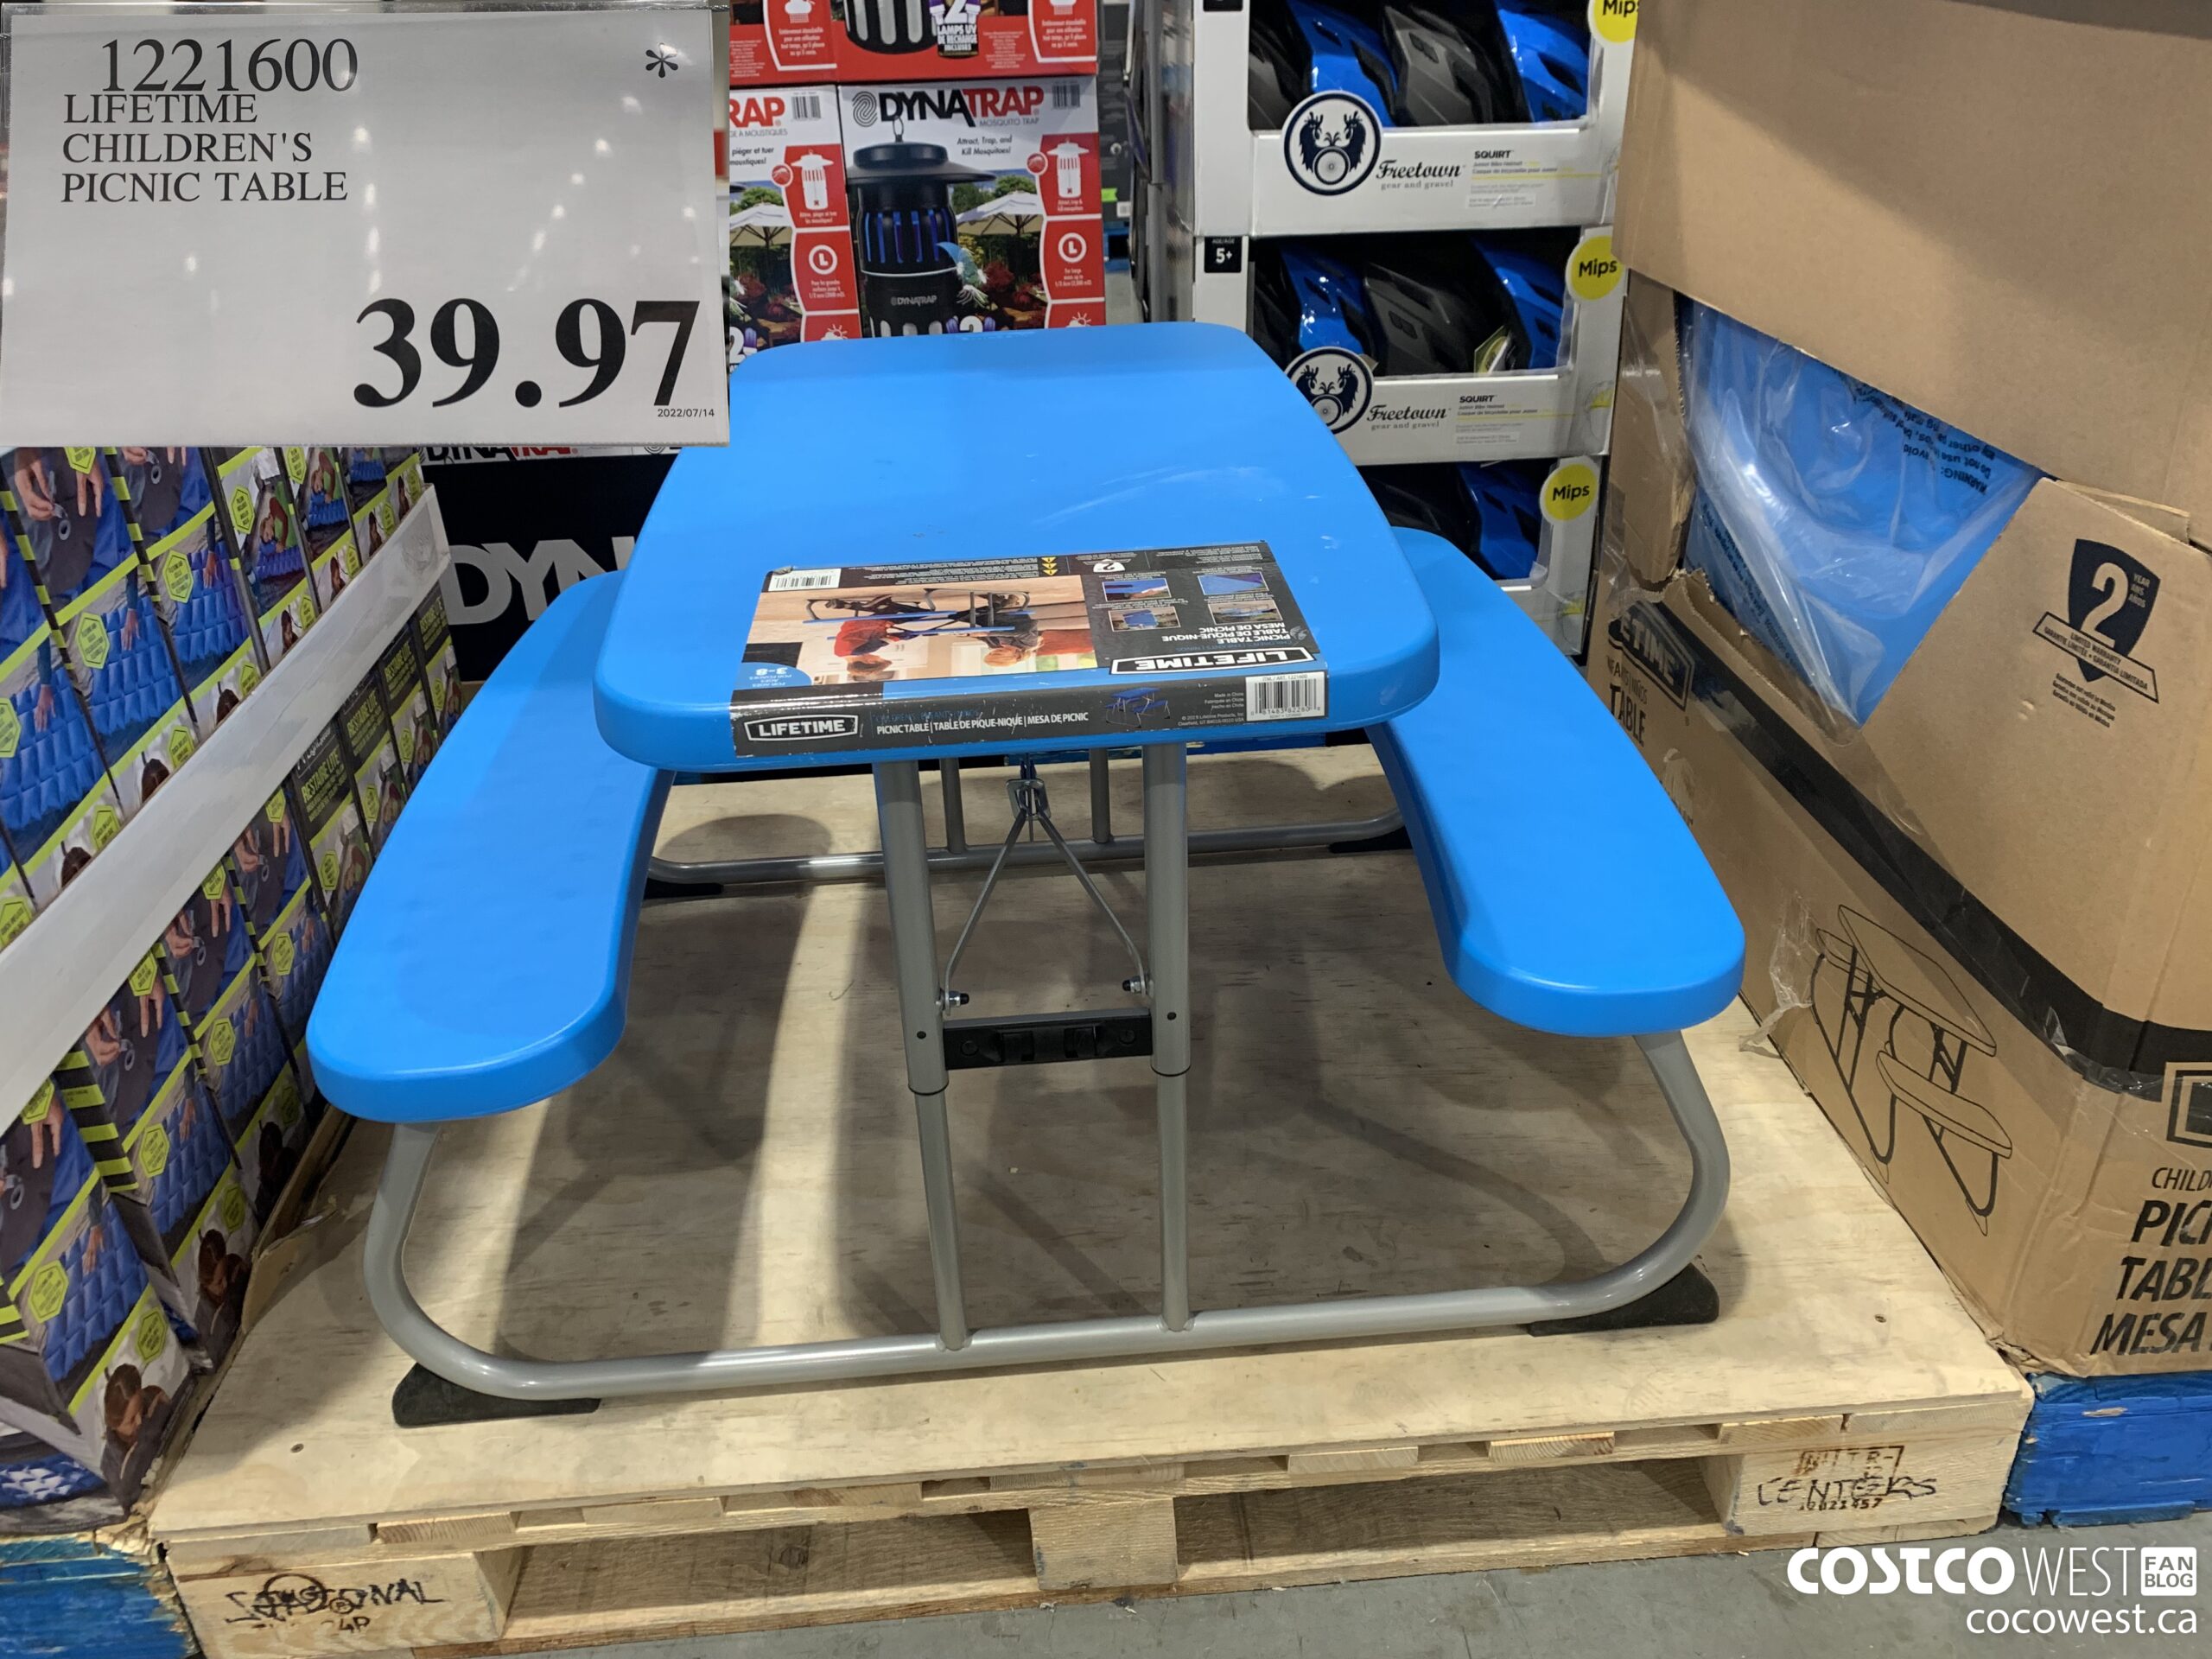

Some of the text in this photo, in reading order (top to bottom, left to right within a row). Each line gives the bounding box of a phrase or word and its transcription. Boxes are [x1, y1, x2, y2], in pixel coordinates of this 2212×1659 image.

[965, 24, 977, 34] UV
[101, 38, 359, 93] 1221600
[63, 93, 257, 124] LIFETIME
[879, 86, 1045, 128] DYNATRAP
[979, 117, 1039, 127] MOSQUITO TRAP
[745, 128, 788, 137] MOUSTIQUES
[999, 135, 1013, 144] and
[62, 132, 313, 164] CHILDREN'S
[973, 146, 1011, 156] Mosquitoes!
[1474, 149, 1510, 159] SQUIRT
[1376, 159, 1462, 179] Freetown
[60, 171, 347, 203] PICNIC TABLE
[1381, 180, 1453, 191] gear and gravel
[1215, 247, 1233, 264] 5+
[1579, 257, 1618, 278] Mips
[897, 296, 938, 307] DYNATRAP
[353, 297, 701, 410] 39.97
[1459, 395, 1494, 404] SQUIRT
[657, 409, 715, 419] 2022/07/14
[1367, 404, 1447, 421] Freetown
[1371, 423, 1390, 431] gear
[1412, 420, 1440, 430] gravel
[1552, 484, 1590, 501] Mips
[2133, 572, 2151, 588] YEAR
[2080, 562, 2129, 649] 2
[1162, 627, 1289, 642] TABLE DE PIQUE-NIQUE
[1198, 626, 1236, 634] PICNIC
[1256, 622, 1286, 631] MESA
[1217, 634, 1291, 645] PICNIC TABLE
[1135, 650, 1288, 671] LIFETIME
[759, 719, 845, 737] LIFETIME
[876, 712, 1089, 734] PICNIC TABLE TABLE DE PIQUE-NIQUE MESA DE PICNIC
[2089, 1312, 2208, 1357] MESA
